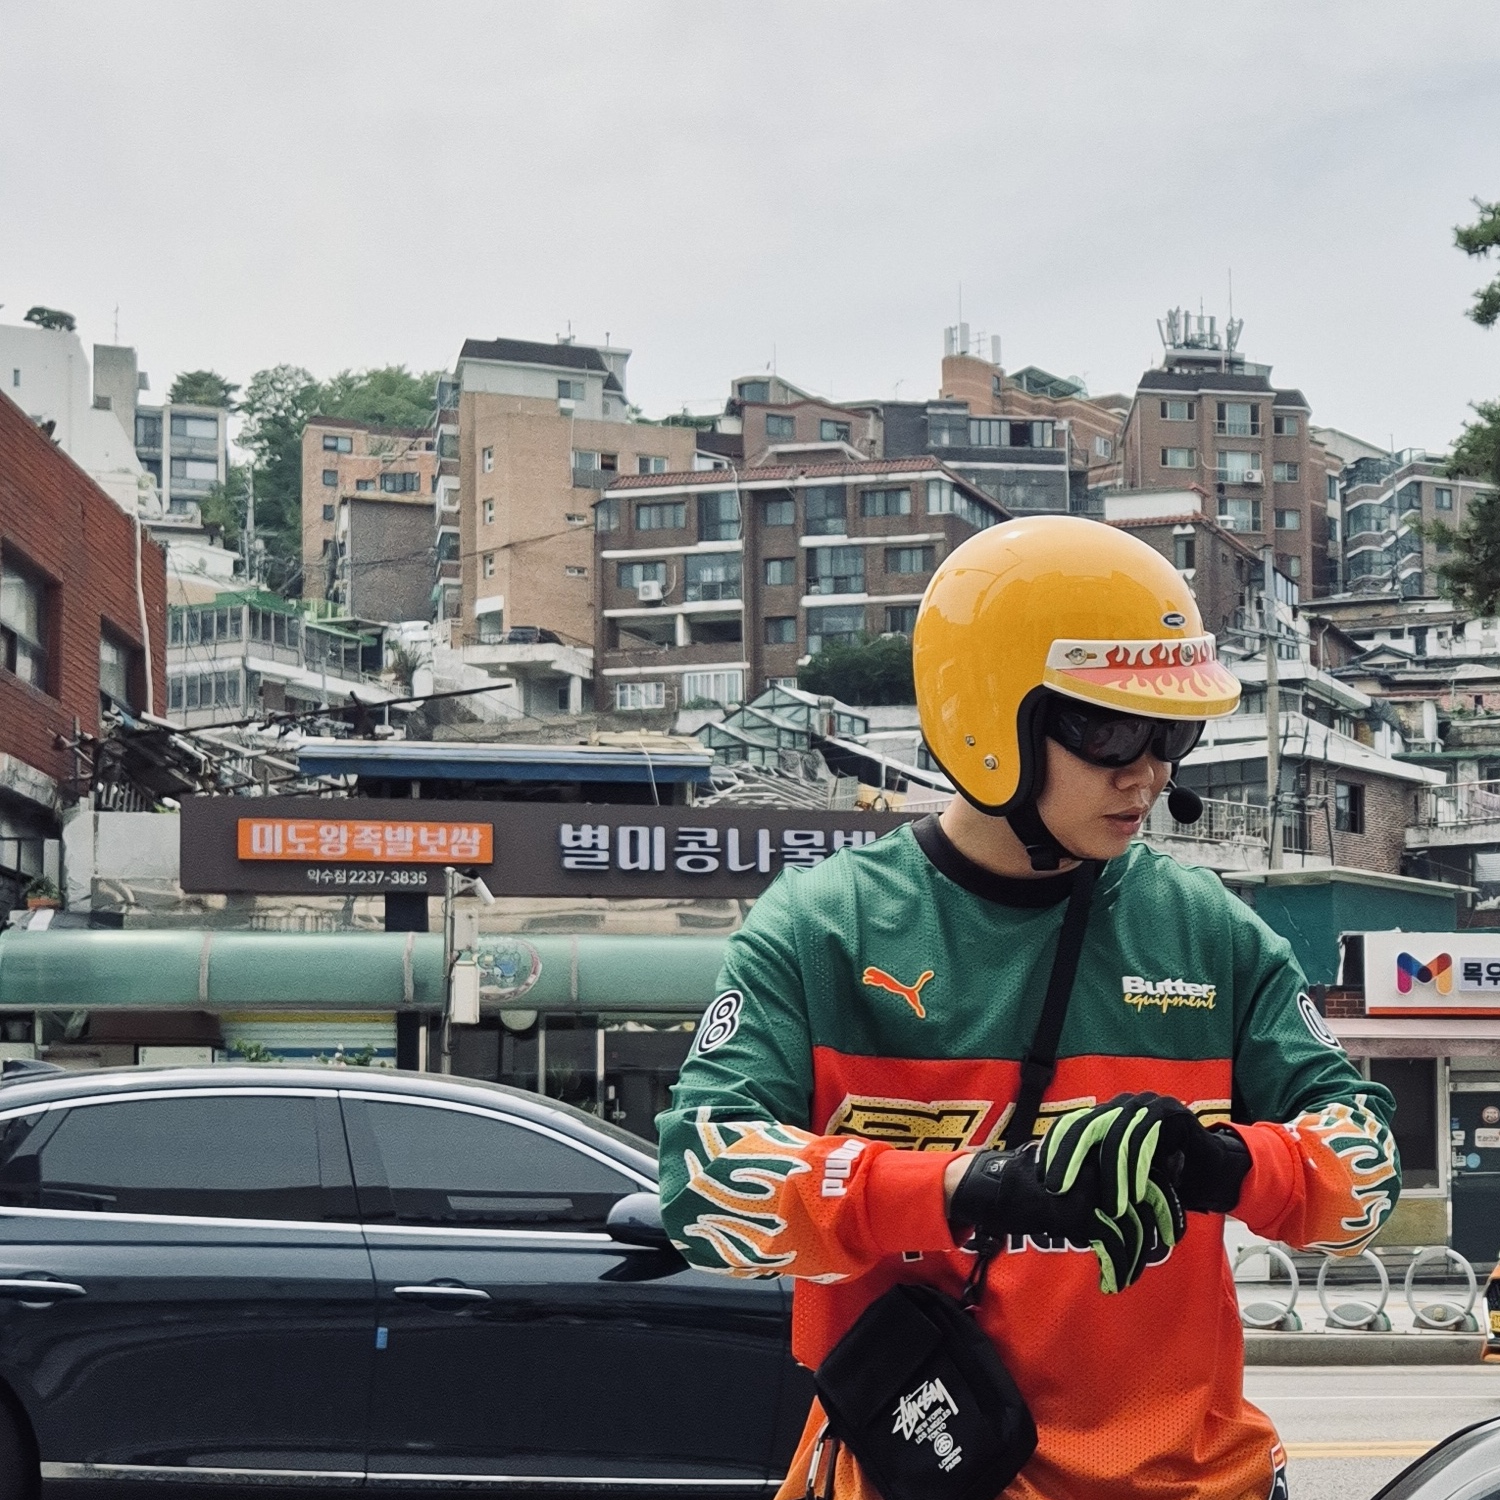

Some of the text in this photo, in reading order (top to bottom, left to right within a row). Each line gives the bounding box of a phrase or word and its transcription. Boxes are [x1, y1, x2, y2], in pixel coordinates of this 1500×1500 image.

[251, 823, 482, 859] 미도왕족발보쌈
[307, 869, 428, 886] 약수점 2237-3835
[1122, 976, 1216, 998] Butter
[1124, 993, 1217, 1014] equipment
[698, 991, 743, 1054] 8
[820, 1138, 867, 1198] PUM
